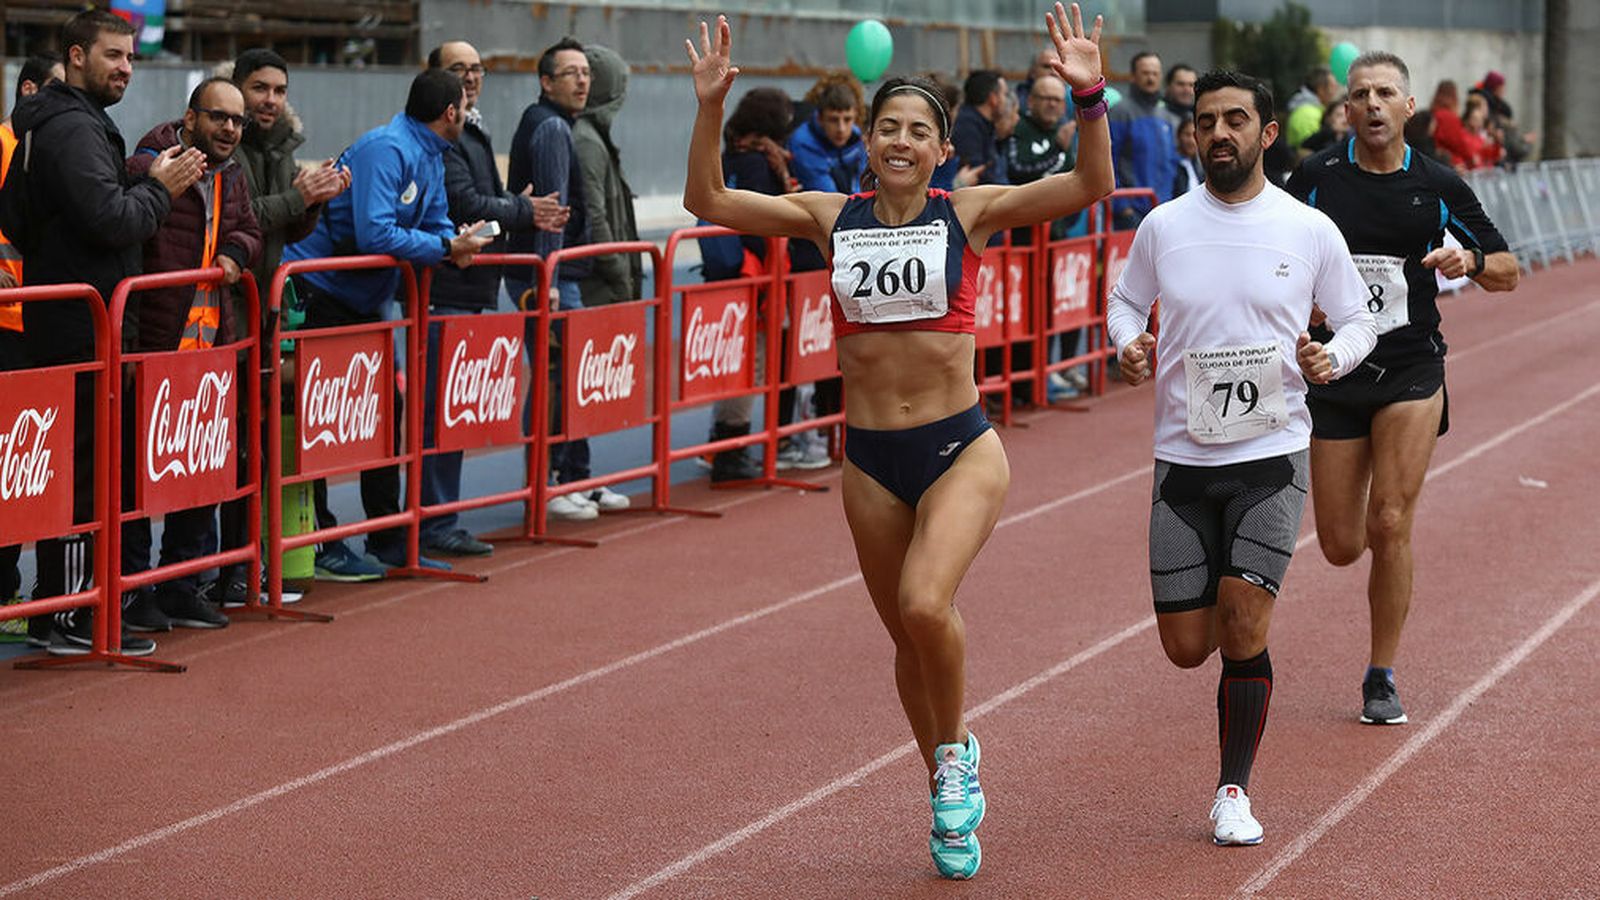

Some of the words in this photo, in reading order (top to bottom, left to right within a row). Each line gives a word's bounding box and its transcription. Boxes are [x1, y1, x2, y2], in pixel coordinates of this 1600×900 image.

[896, 229, 941, 237] POPULAR
[849, 257, 926, 298] 260
[577, 333, 637, 407] Coca-Cola
[1199, 350, 1237, 359] CARRERA
[1239, 346, 1276, 356] POPULAR
[302, 351, 384, 450] Coca-Cola
[444, 336, 521, 428] Coca-Cola
[1212, 381, 1259, 418] 79
